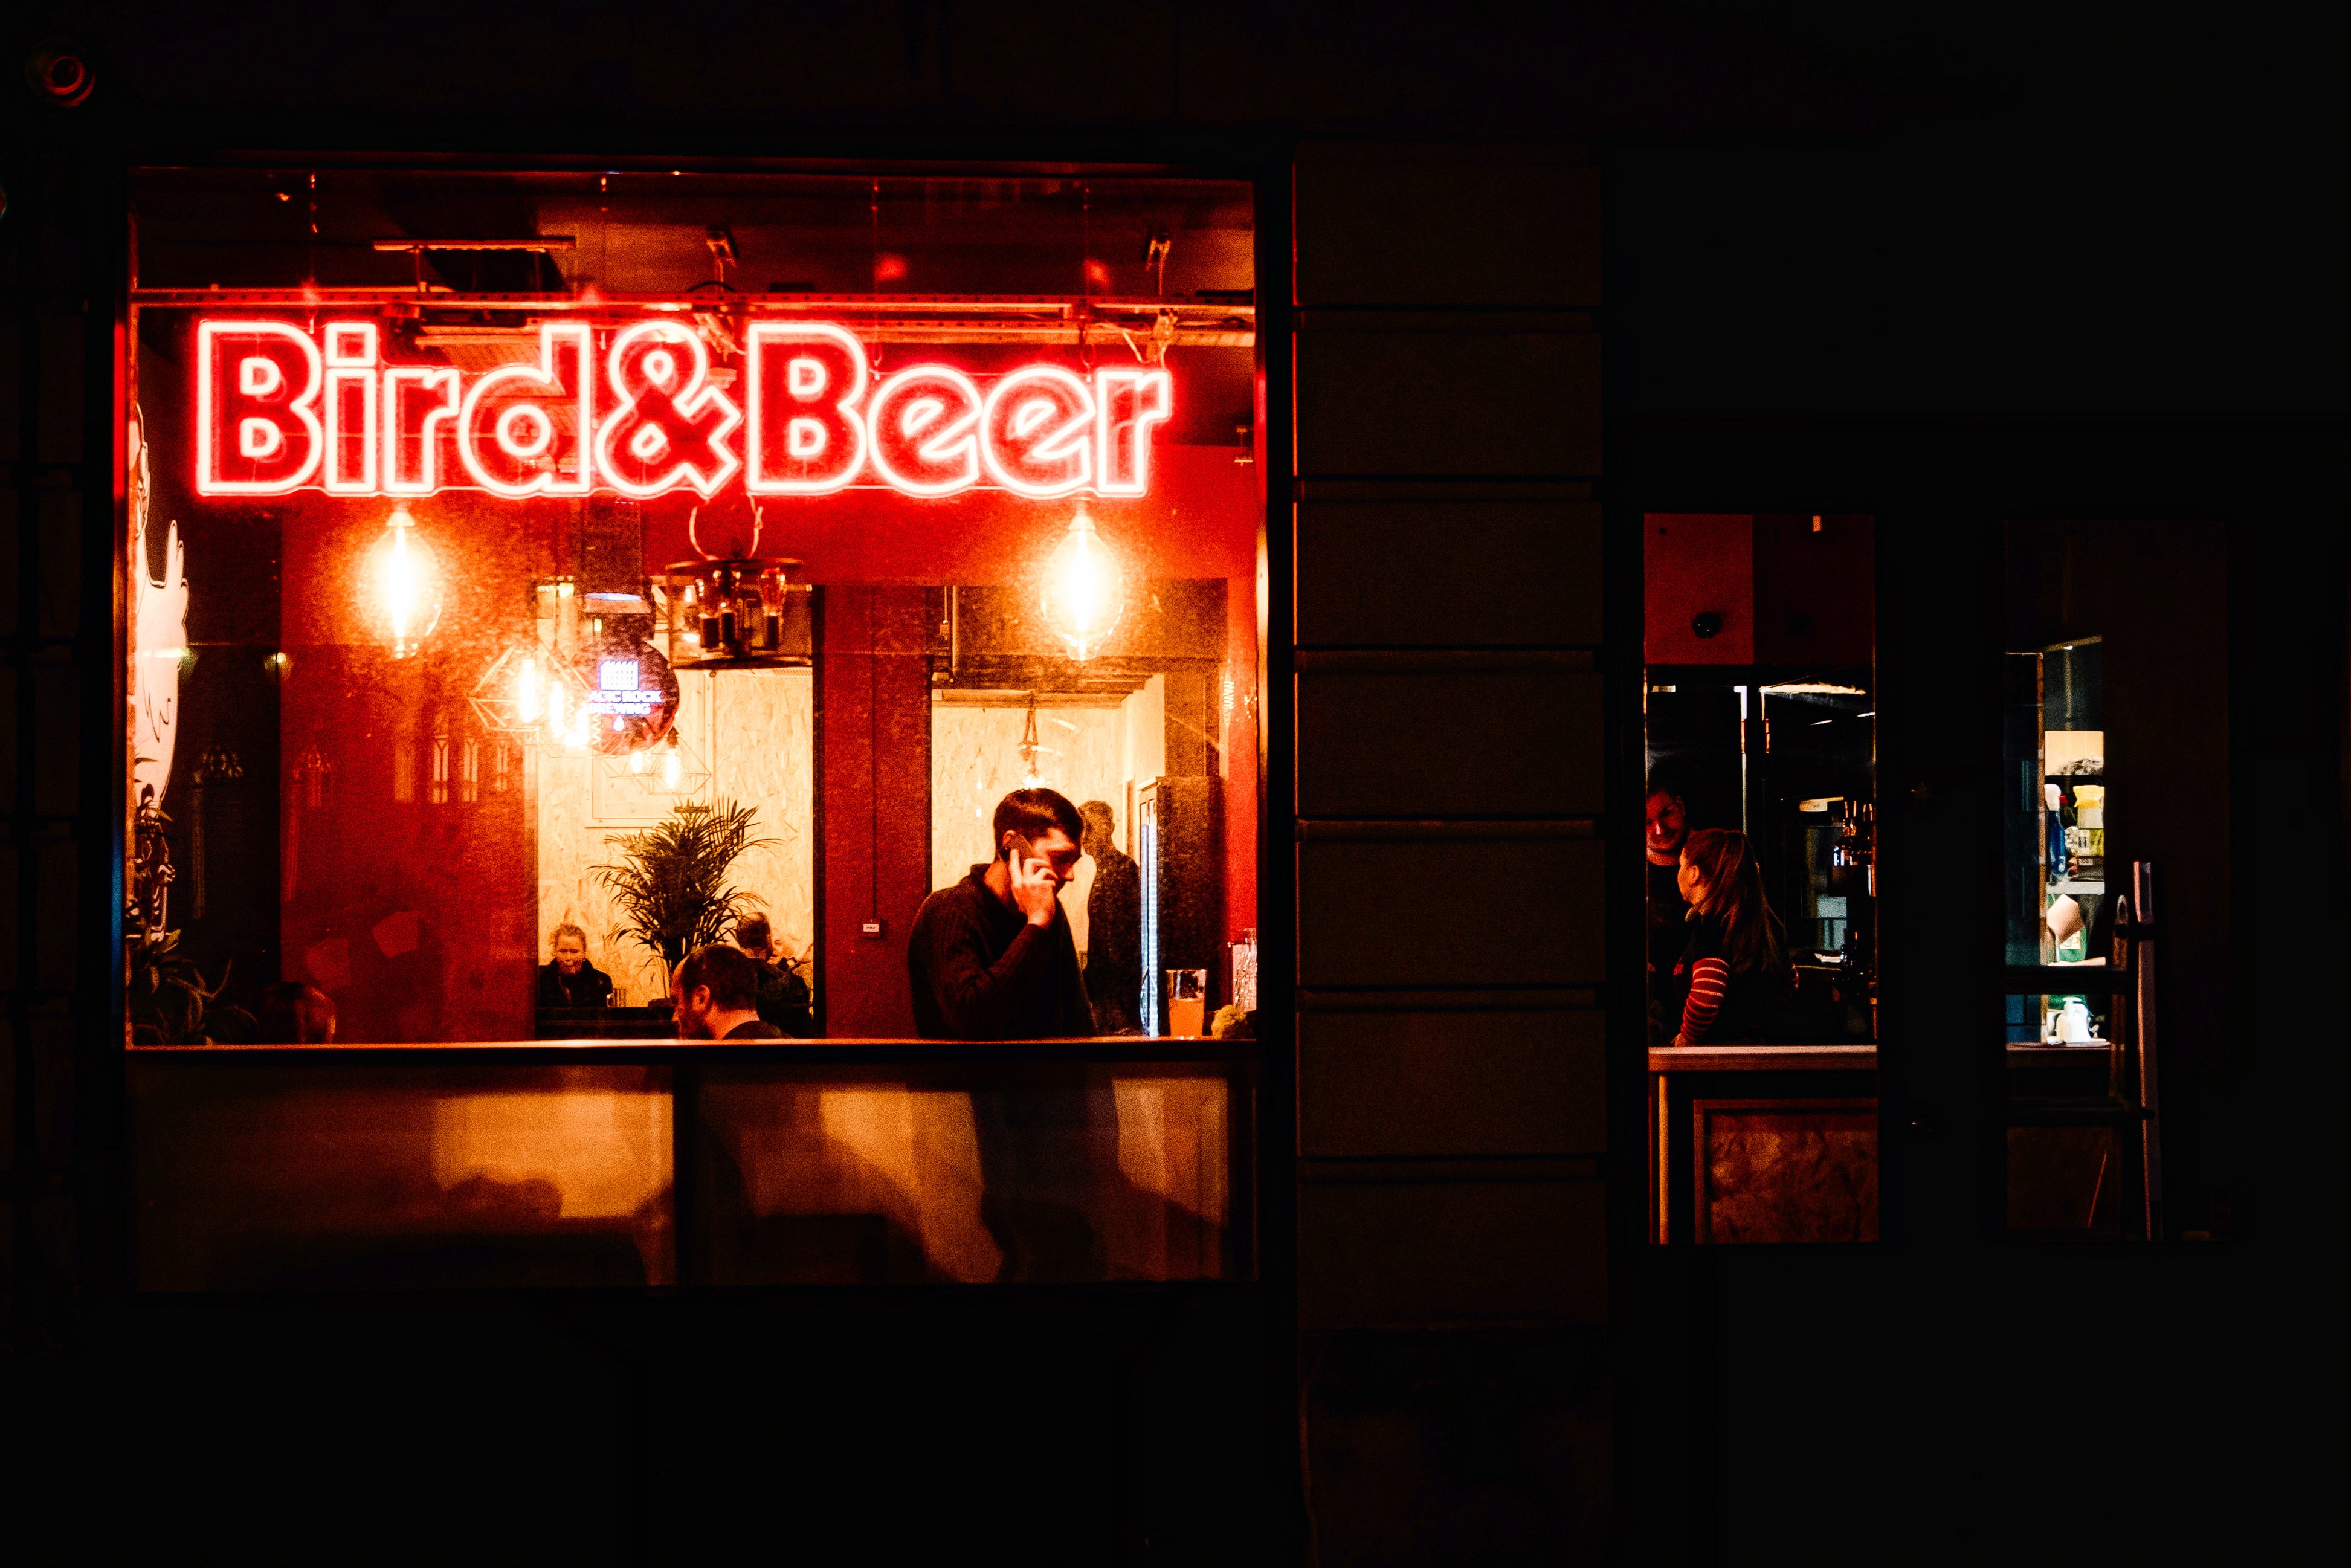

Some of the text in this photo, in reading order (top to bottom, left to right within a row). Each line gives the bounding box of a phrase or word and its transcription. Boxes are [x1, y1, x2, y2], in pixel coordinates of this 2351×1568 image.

[197, 319, 1171, 500] Bird&Beer
[585, 689, 662, 703] AGIC ROCK
[588, 702, 651, 715] BREWING
